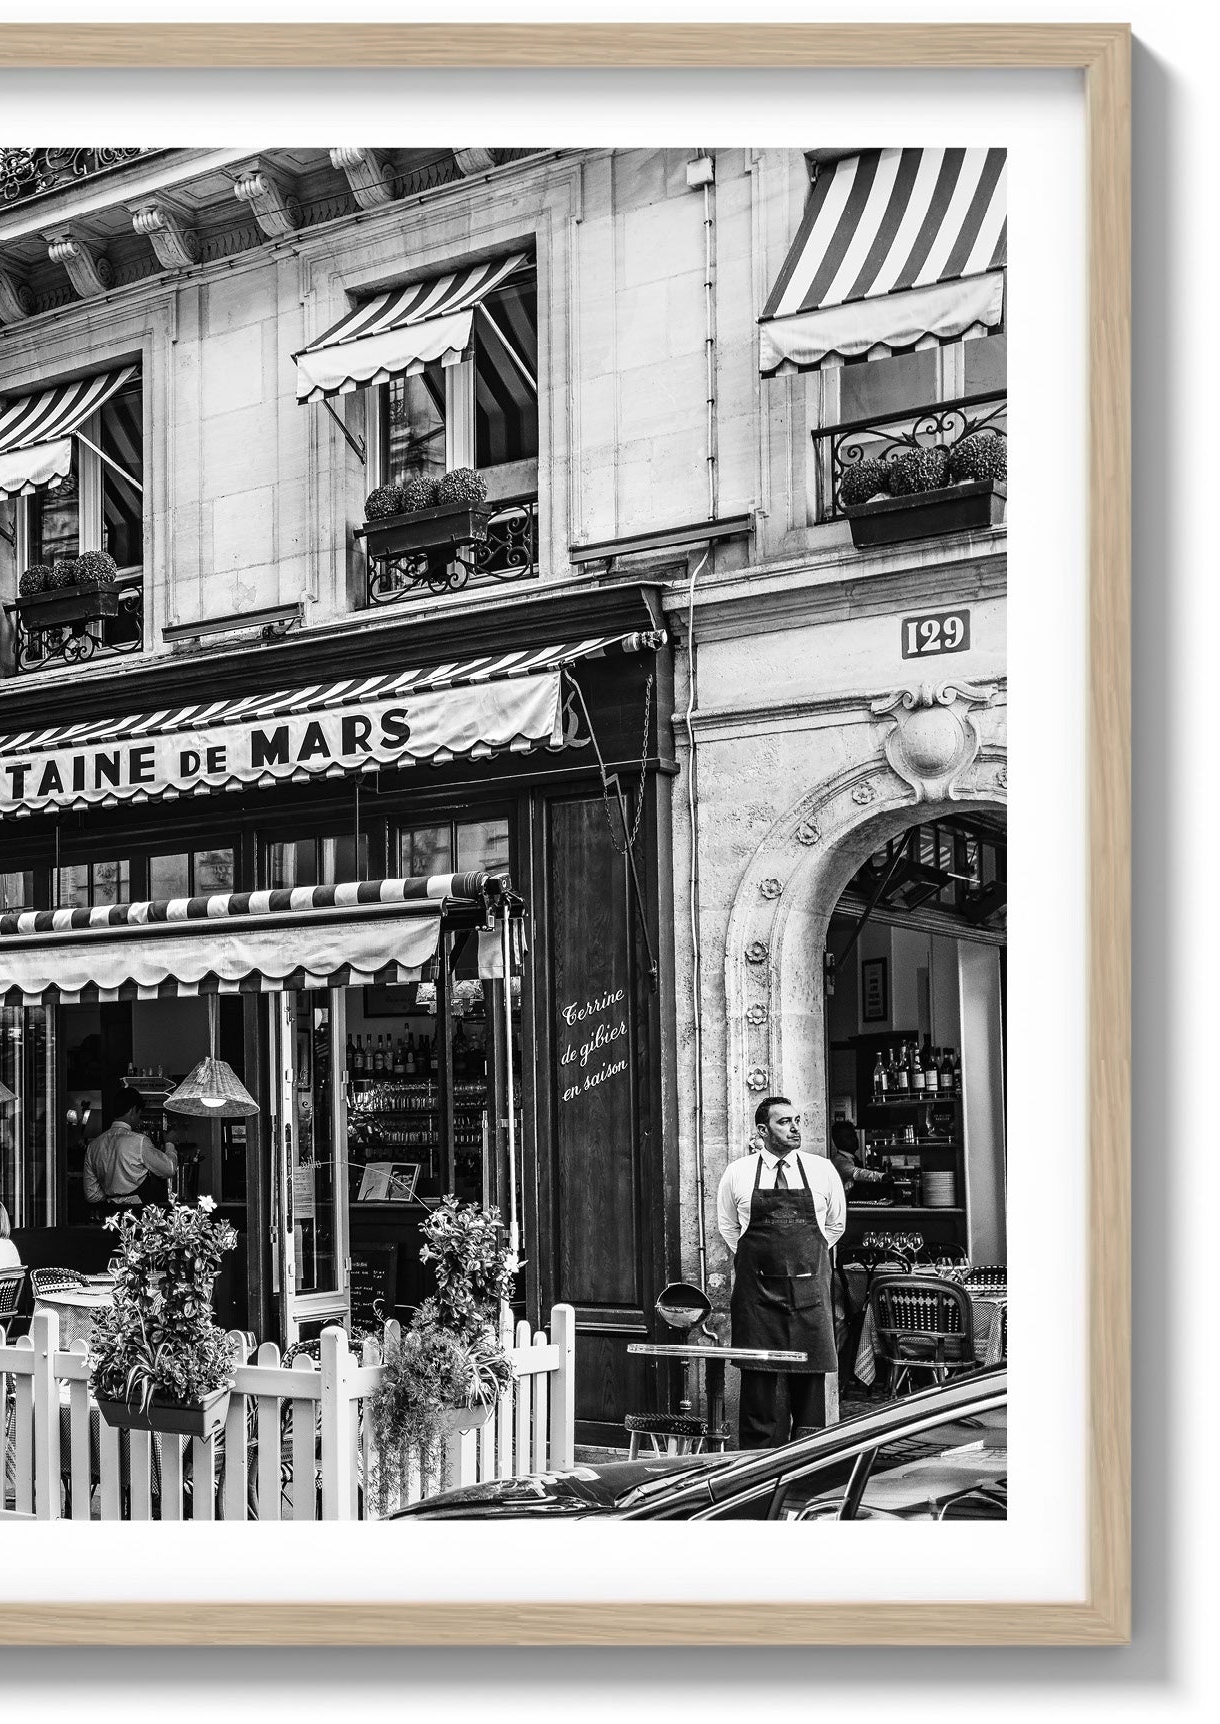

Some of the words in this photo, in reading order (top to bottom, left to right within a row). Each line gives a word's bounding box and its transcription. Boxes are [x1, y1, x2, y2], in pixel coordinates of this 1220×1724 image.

[907, 616, 964, 654] 129
[180, 746, 227, 778] DE
[251, 708, 411, 768] MARS
[562, 989, 625, 1026] Terrine
[561, 1044, 578, 1065] de
[579, 1020, 628, 1067] gibier
[562, 1085, 582, 1102] en
[583, 1059, 629, 1091] saison
